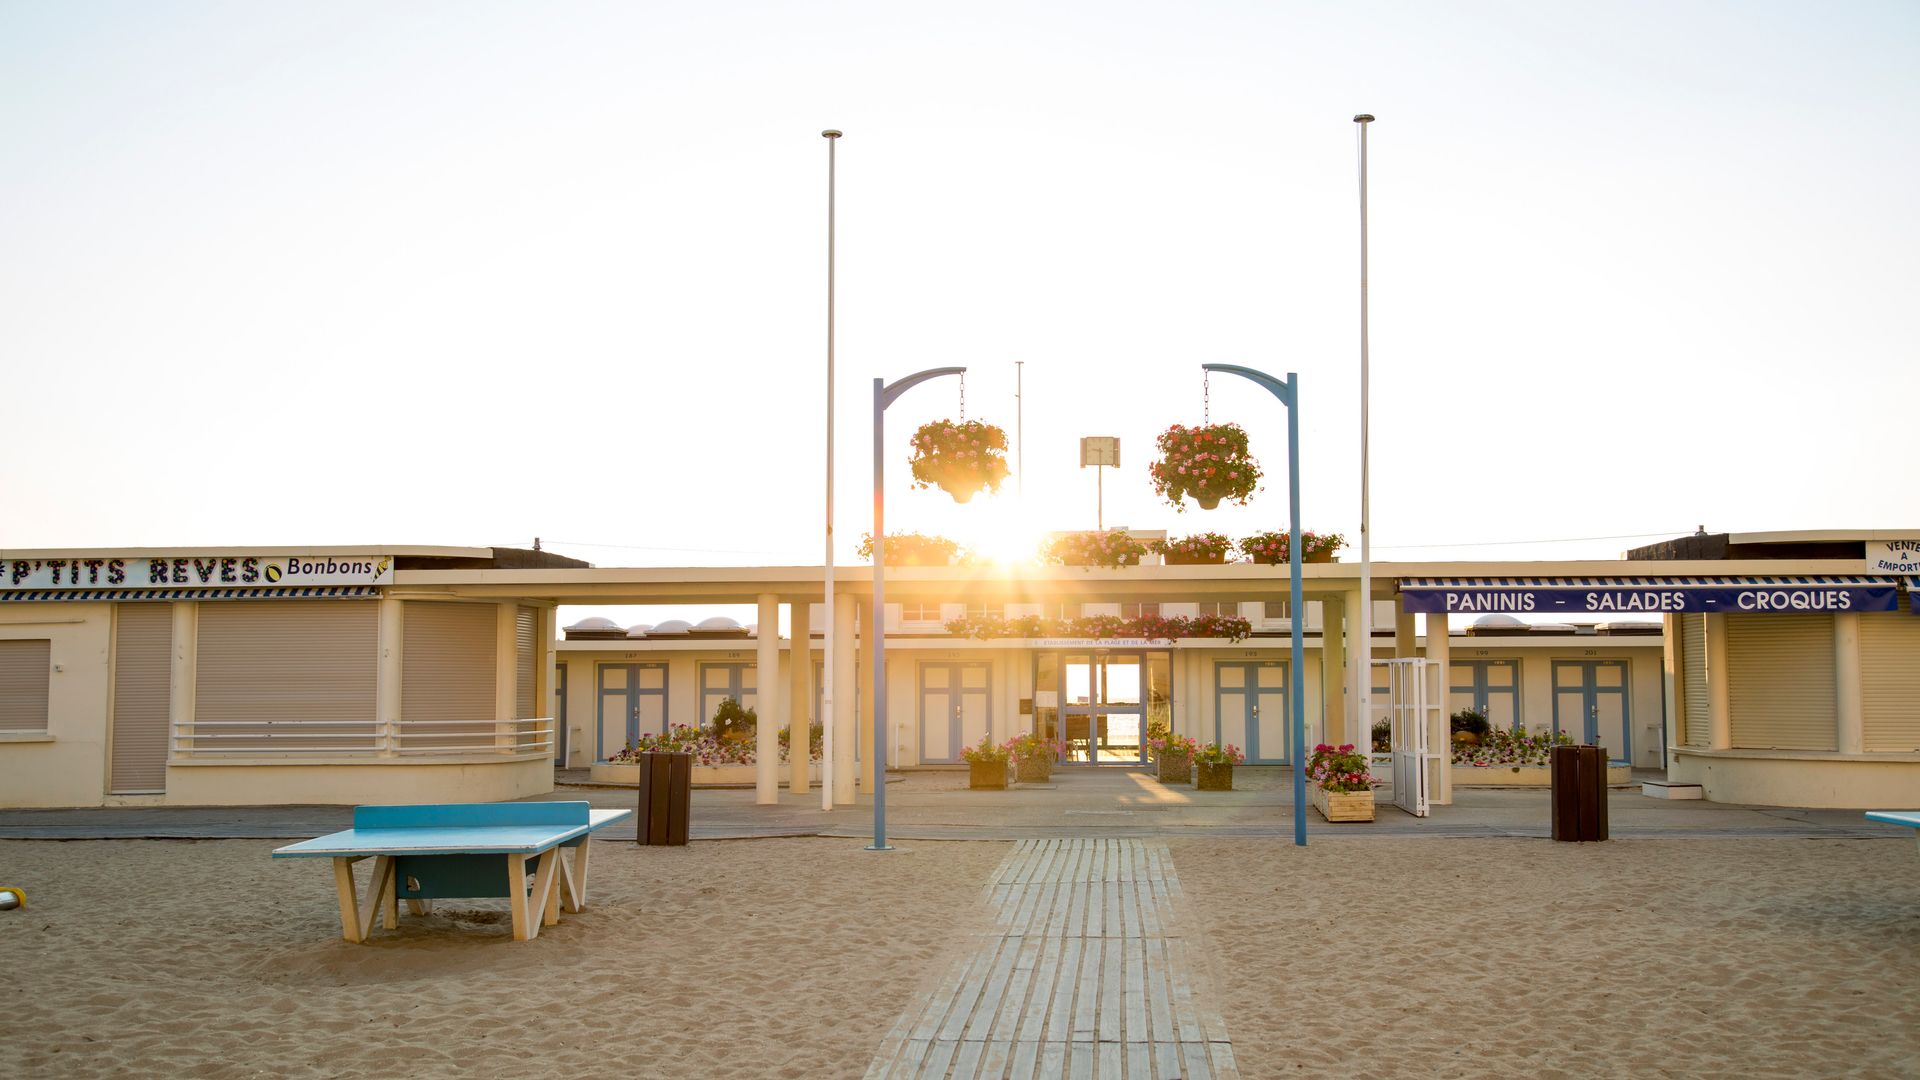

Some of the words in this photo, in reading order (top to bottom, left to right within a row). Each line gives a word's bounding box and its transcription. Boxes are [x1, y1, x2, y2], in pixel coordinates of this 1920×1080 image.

[1886, 540, 1920, 552] VENTE
[1901, 552, 1908, 560] A
[11, 558, 126, 585] P'TITS
[149, 557, 261, 584] REVES
[287, 557, 372, 575] Bonbons
[1446, 592, 1535, 611] PANINIS
[1586, 592, 1685, 611] SALADES
[1737, 591, 1851, 611] CROQUES
